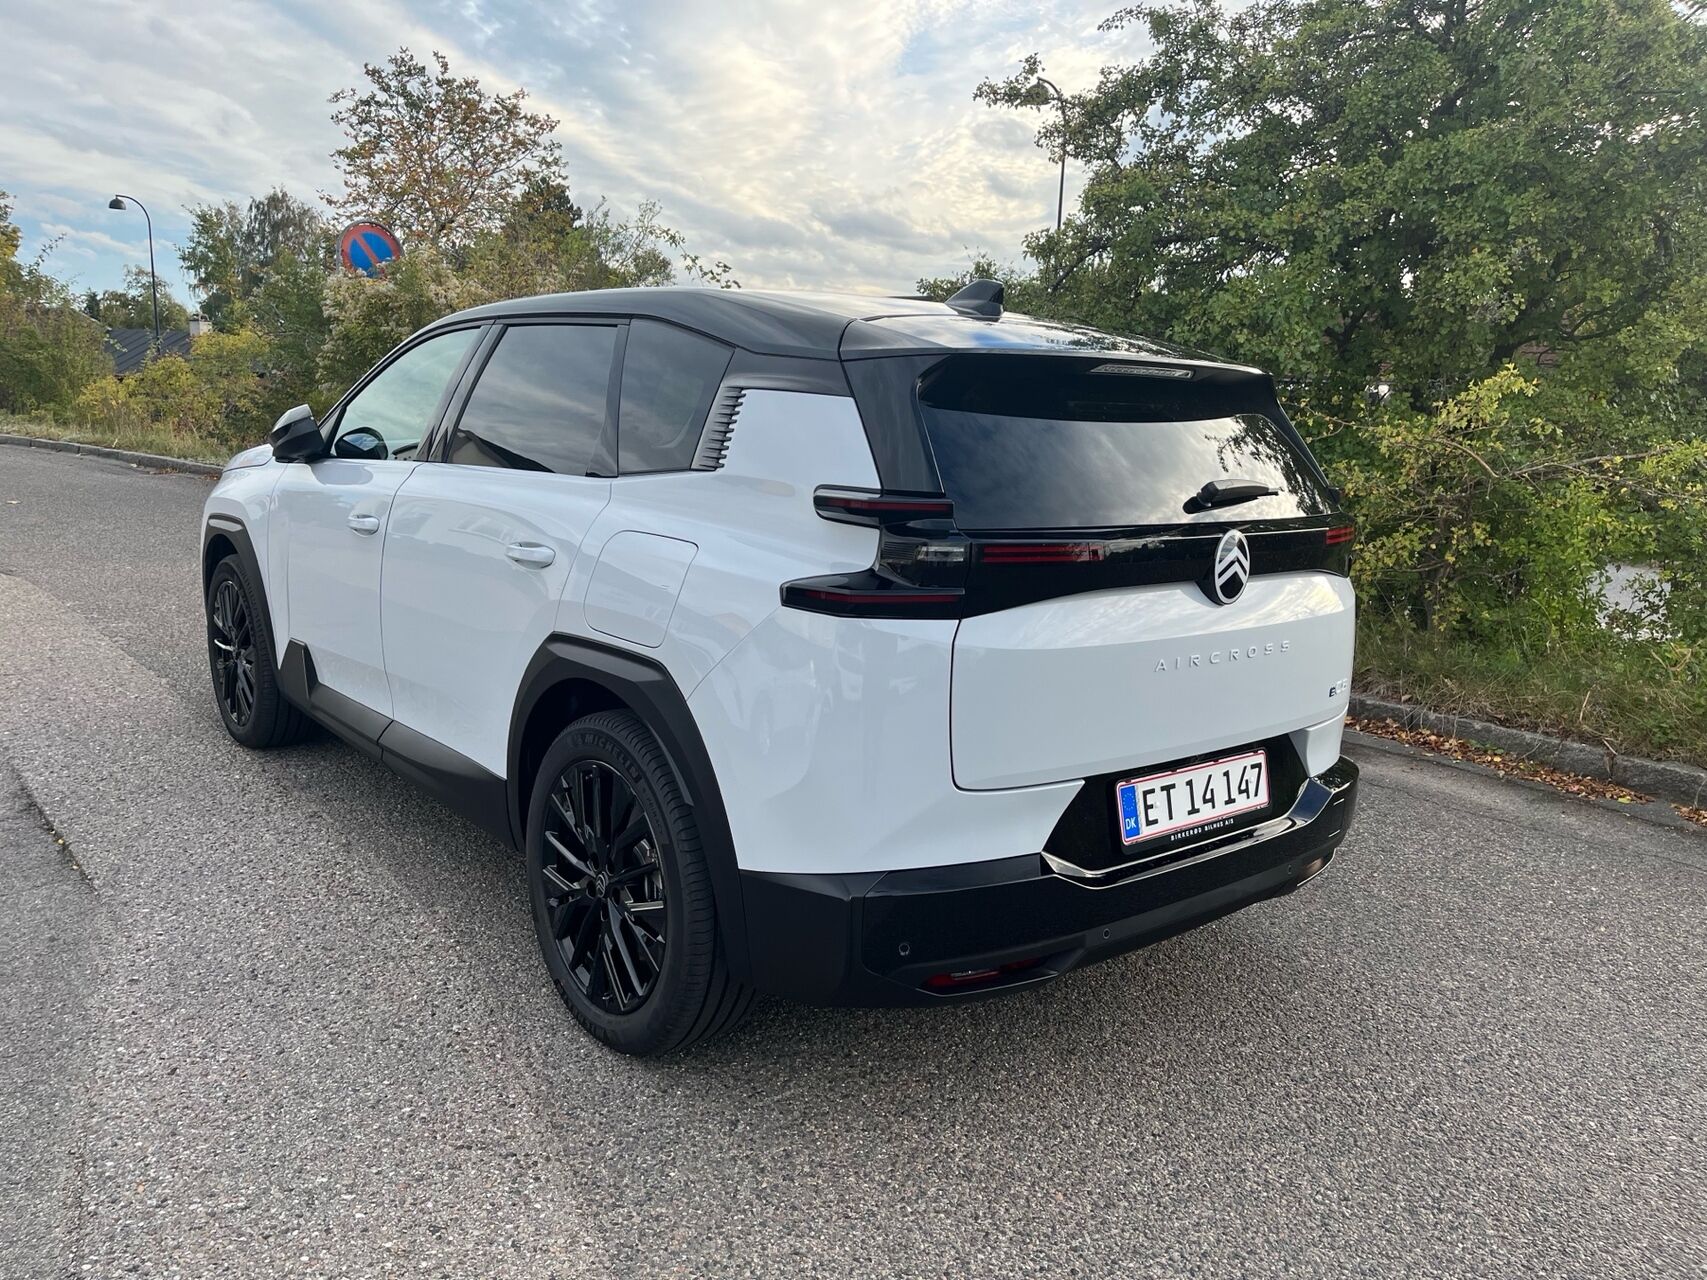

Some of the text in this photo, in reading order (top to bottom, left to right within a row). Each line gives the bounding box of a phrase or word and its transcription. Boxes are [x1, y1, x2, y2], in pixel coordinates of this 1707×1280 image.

[1154, 640, 1291, 672] AIRCROSS
[584, 733, 639, 779] MICHELIN
[1142, 761, 1263, 827] ET 14 147
[1125, 816, 1137, 830] DK
